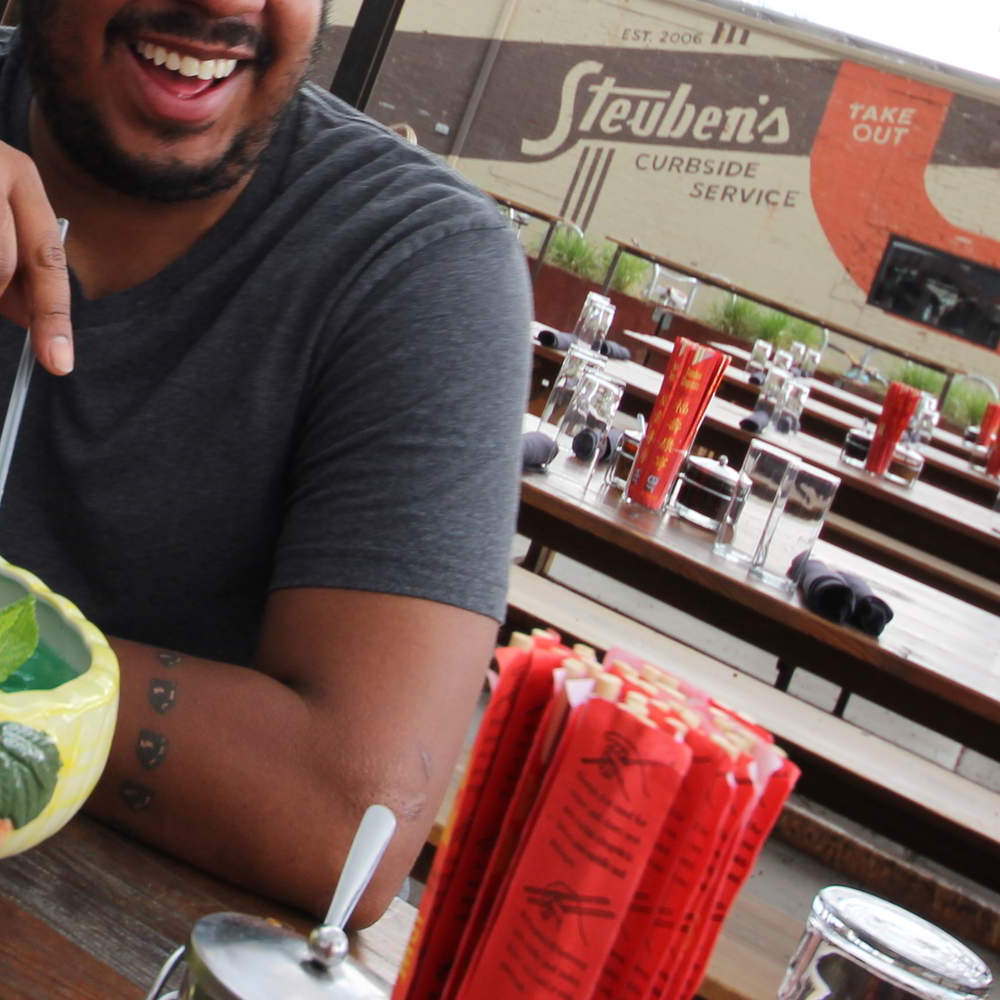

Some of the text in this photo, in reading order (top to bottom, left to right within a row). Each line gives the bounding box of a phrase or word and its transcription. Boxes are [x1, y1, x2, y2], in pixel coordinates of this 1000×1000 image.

[621, 28, 703, 45] EST. 2006
[520, 60, 791, 156] Steuben's
[850, 102, 917, 125] TAKE
[852, 123, 910, 145] OUT
[635, 152, 760, 179] CURBSIDE
[689, 182, 800, 208] SERVICE
